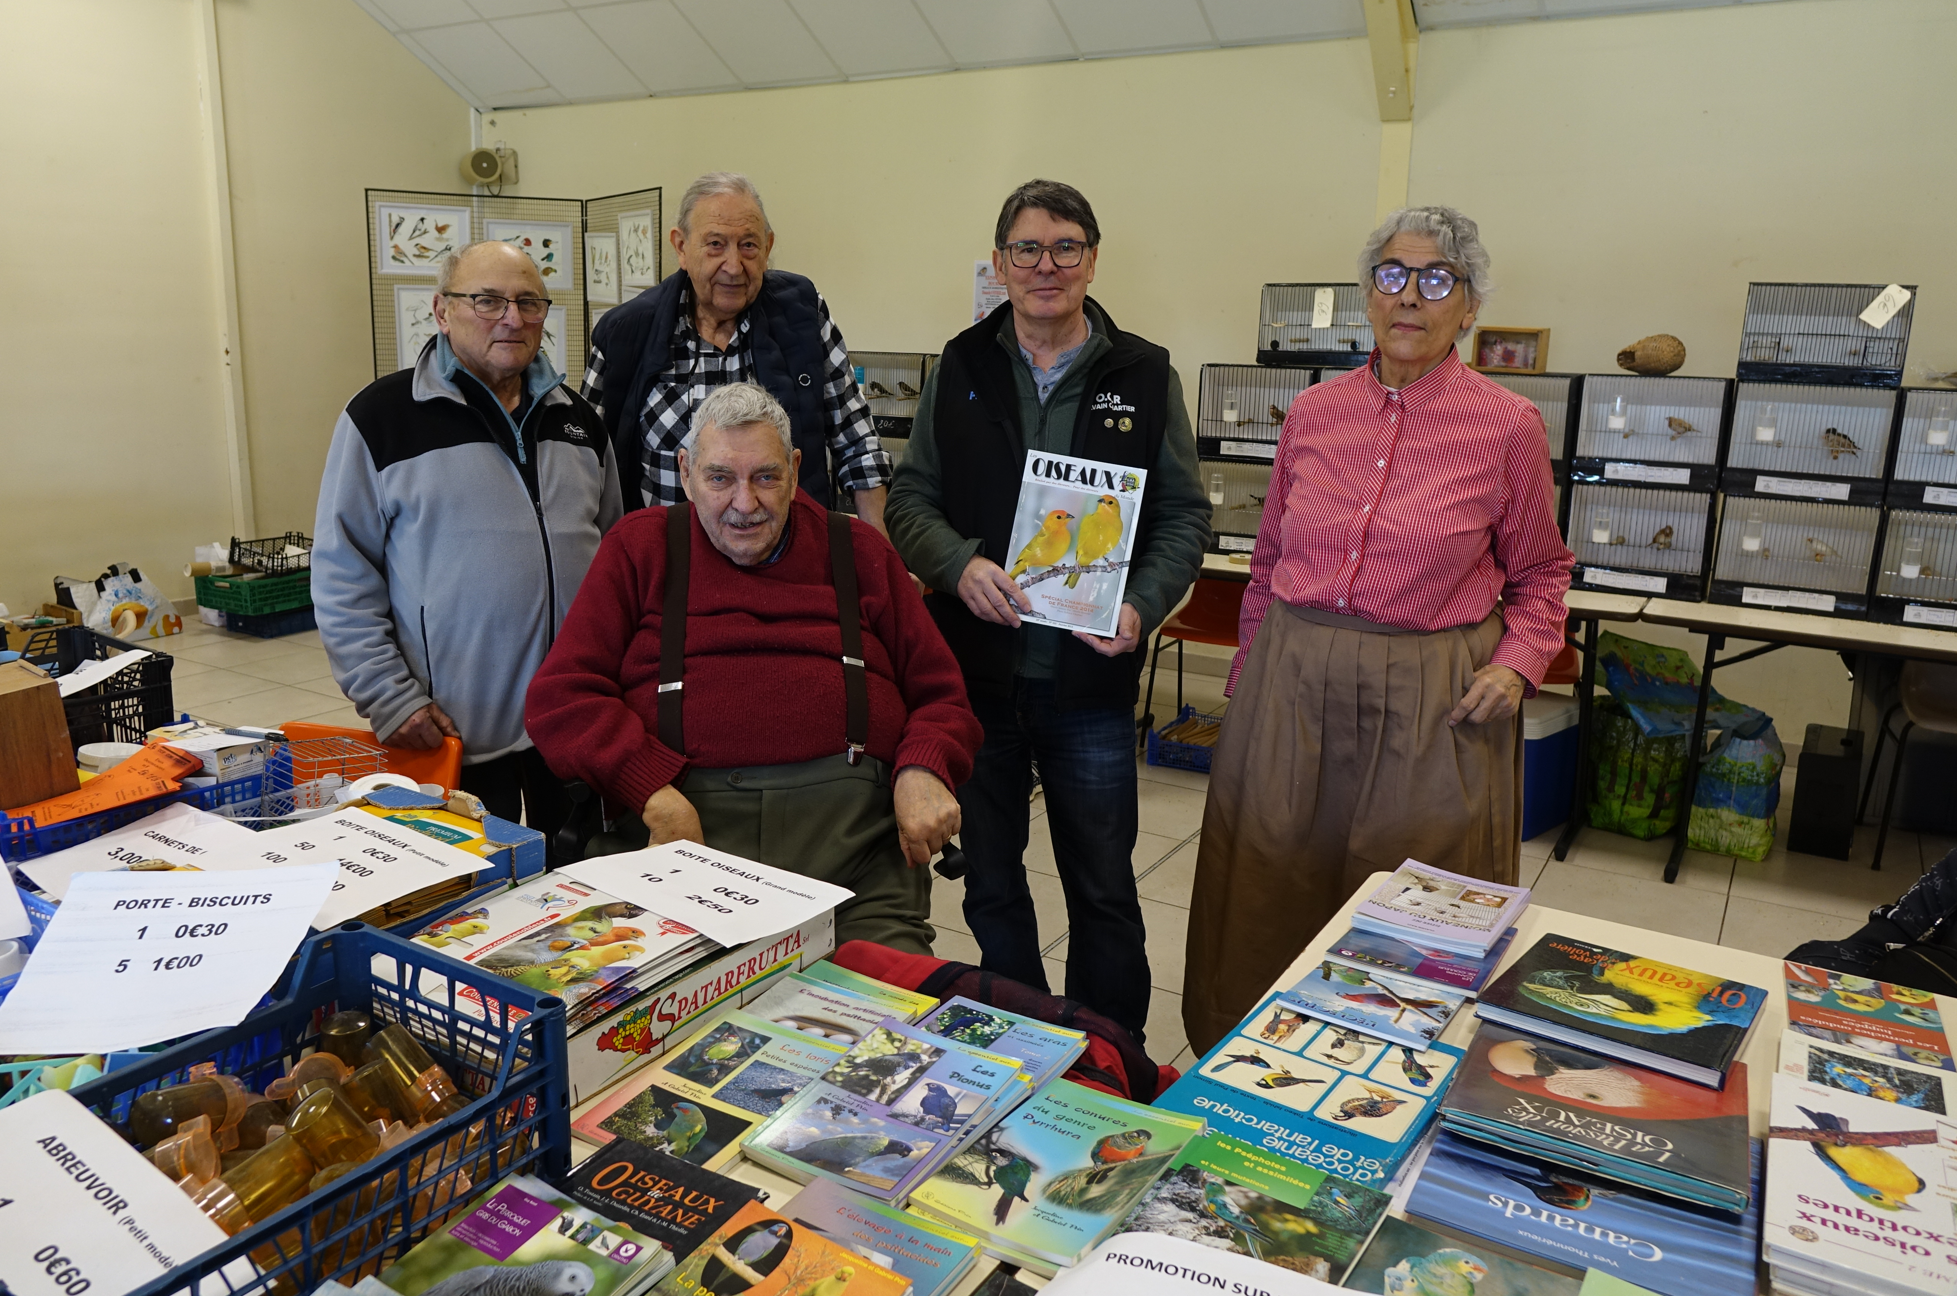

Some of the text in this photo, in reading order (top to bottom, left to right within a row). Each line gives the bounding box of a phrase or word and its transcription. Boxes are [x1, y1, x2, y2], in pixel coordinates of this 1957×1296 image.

[1032, 457, 1118, 490] OISEAUX
[1056, 601, 1079, 610] FRANCE
[144, 830, 202, 856] CARNETS DE
[260, 851, 288, 864] 100
[294, 841, 316, 851] 50
[334, 818, 450, 868] BOITE OISEAUX (Petit modèle)
[361, 847, 399, 864] 0€30
[639, 872, 664, 883] 10
[673, 848, 817, 901] BOITE OISEAUX (Grand modèle)
[113, 897, 175, 911] PORTE
[187, 893, 274, 908] BISCUITS
[684, 893, 734, 914] 2€50
[712, 886, 760, 906] 0€30
[136, 922, 230, 940] 1 0€30
[114, 953, 204, 974] 5 1€00
[1568, 953, 1599, 967] cage
[1597, 952, 1610, 963] de
[656, 929, 802, 1038] SPATARFRUTTA
[1616, 960, 1747, 1009] Oiseaux
[821, 1006, 882, 1025] des psittacid
[1841, 1019, 1893, 1036] huppées
[1011, 1026, 1069, 1047] Les aras
[1799, 1015, 1940, 1051] Les perruches ondulées
[760, 1050, 788, 1063] Petites
[779, 1043, 832, 1065] Les loris
[1020, 1046, 1042, 1058] Tome
[948, 1070, 993, 1091] Pionus
[970, 1064, 998, 1078] Les
[1032, 1104, 1098, 1132] du genre
[1044, 1093, 1130, 1129] Les conures
[1511, 1096, 1674, 1151] OISEAUX
[1022, 1112, 1083, 1141] Pyrrhura
[1192, 1095, 1382, 1172] et de l'antarctique
[1502, 1105, 1674, 1163] La Passion des
[1216, 1140, 1288, 1173] les Pséphotes
[1261, 1134, 1374, 1182] d'océanie
[590, 1160, 726, 1215] OISEAUX
[1209, 1162, 1231, 1176] leurs
[1230, 1170, 1271, 1191] mutations
[1242, 1159, 1312, 1191] et assimilées
[35, 1135, 180, 1271] ABREUVOIR (Petit modè
[611, 1186, 706, 1230] GUYANE
[646, 1188, 665, 1200] de
[475, 1209, 490, 1222] GRIS
[487, 1215, 499, 1225] DU
[496, 1219, 523, 1238] GABON
[836, 1205, 954, 1258] L'élevage à la main
[1487, 1193, 1664, 1262] Canards
[1794, 1208, 1932, 1258] oiseaux
[852, 1229, 941, 1269] des psittacidés
[1516, 1229, 1620, 1269] Yves Thonnérieux
[33, 1244, 92, 1296] 0€60
[675, 1269, 696, 1291] La
[1104, 1251, 1228, 1290] PROMOTION
